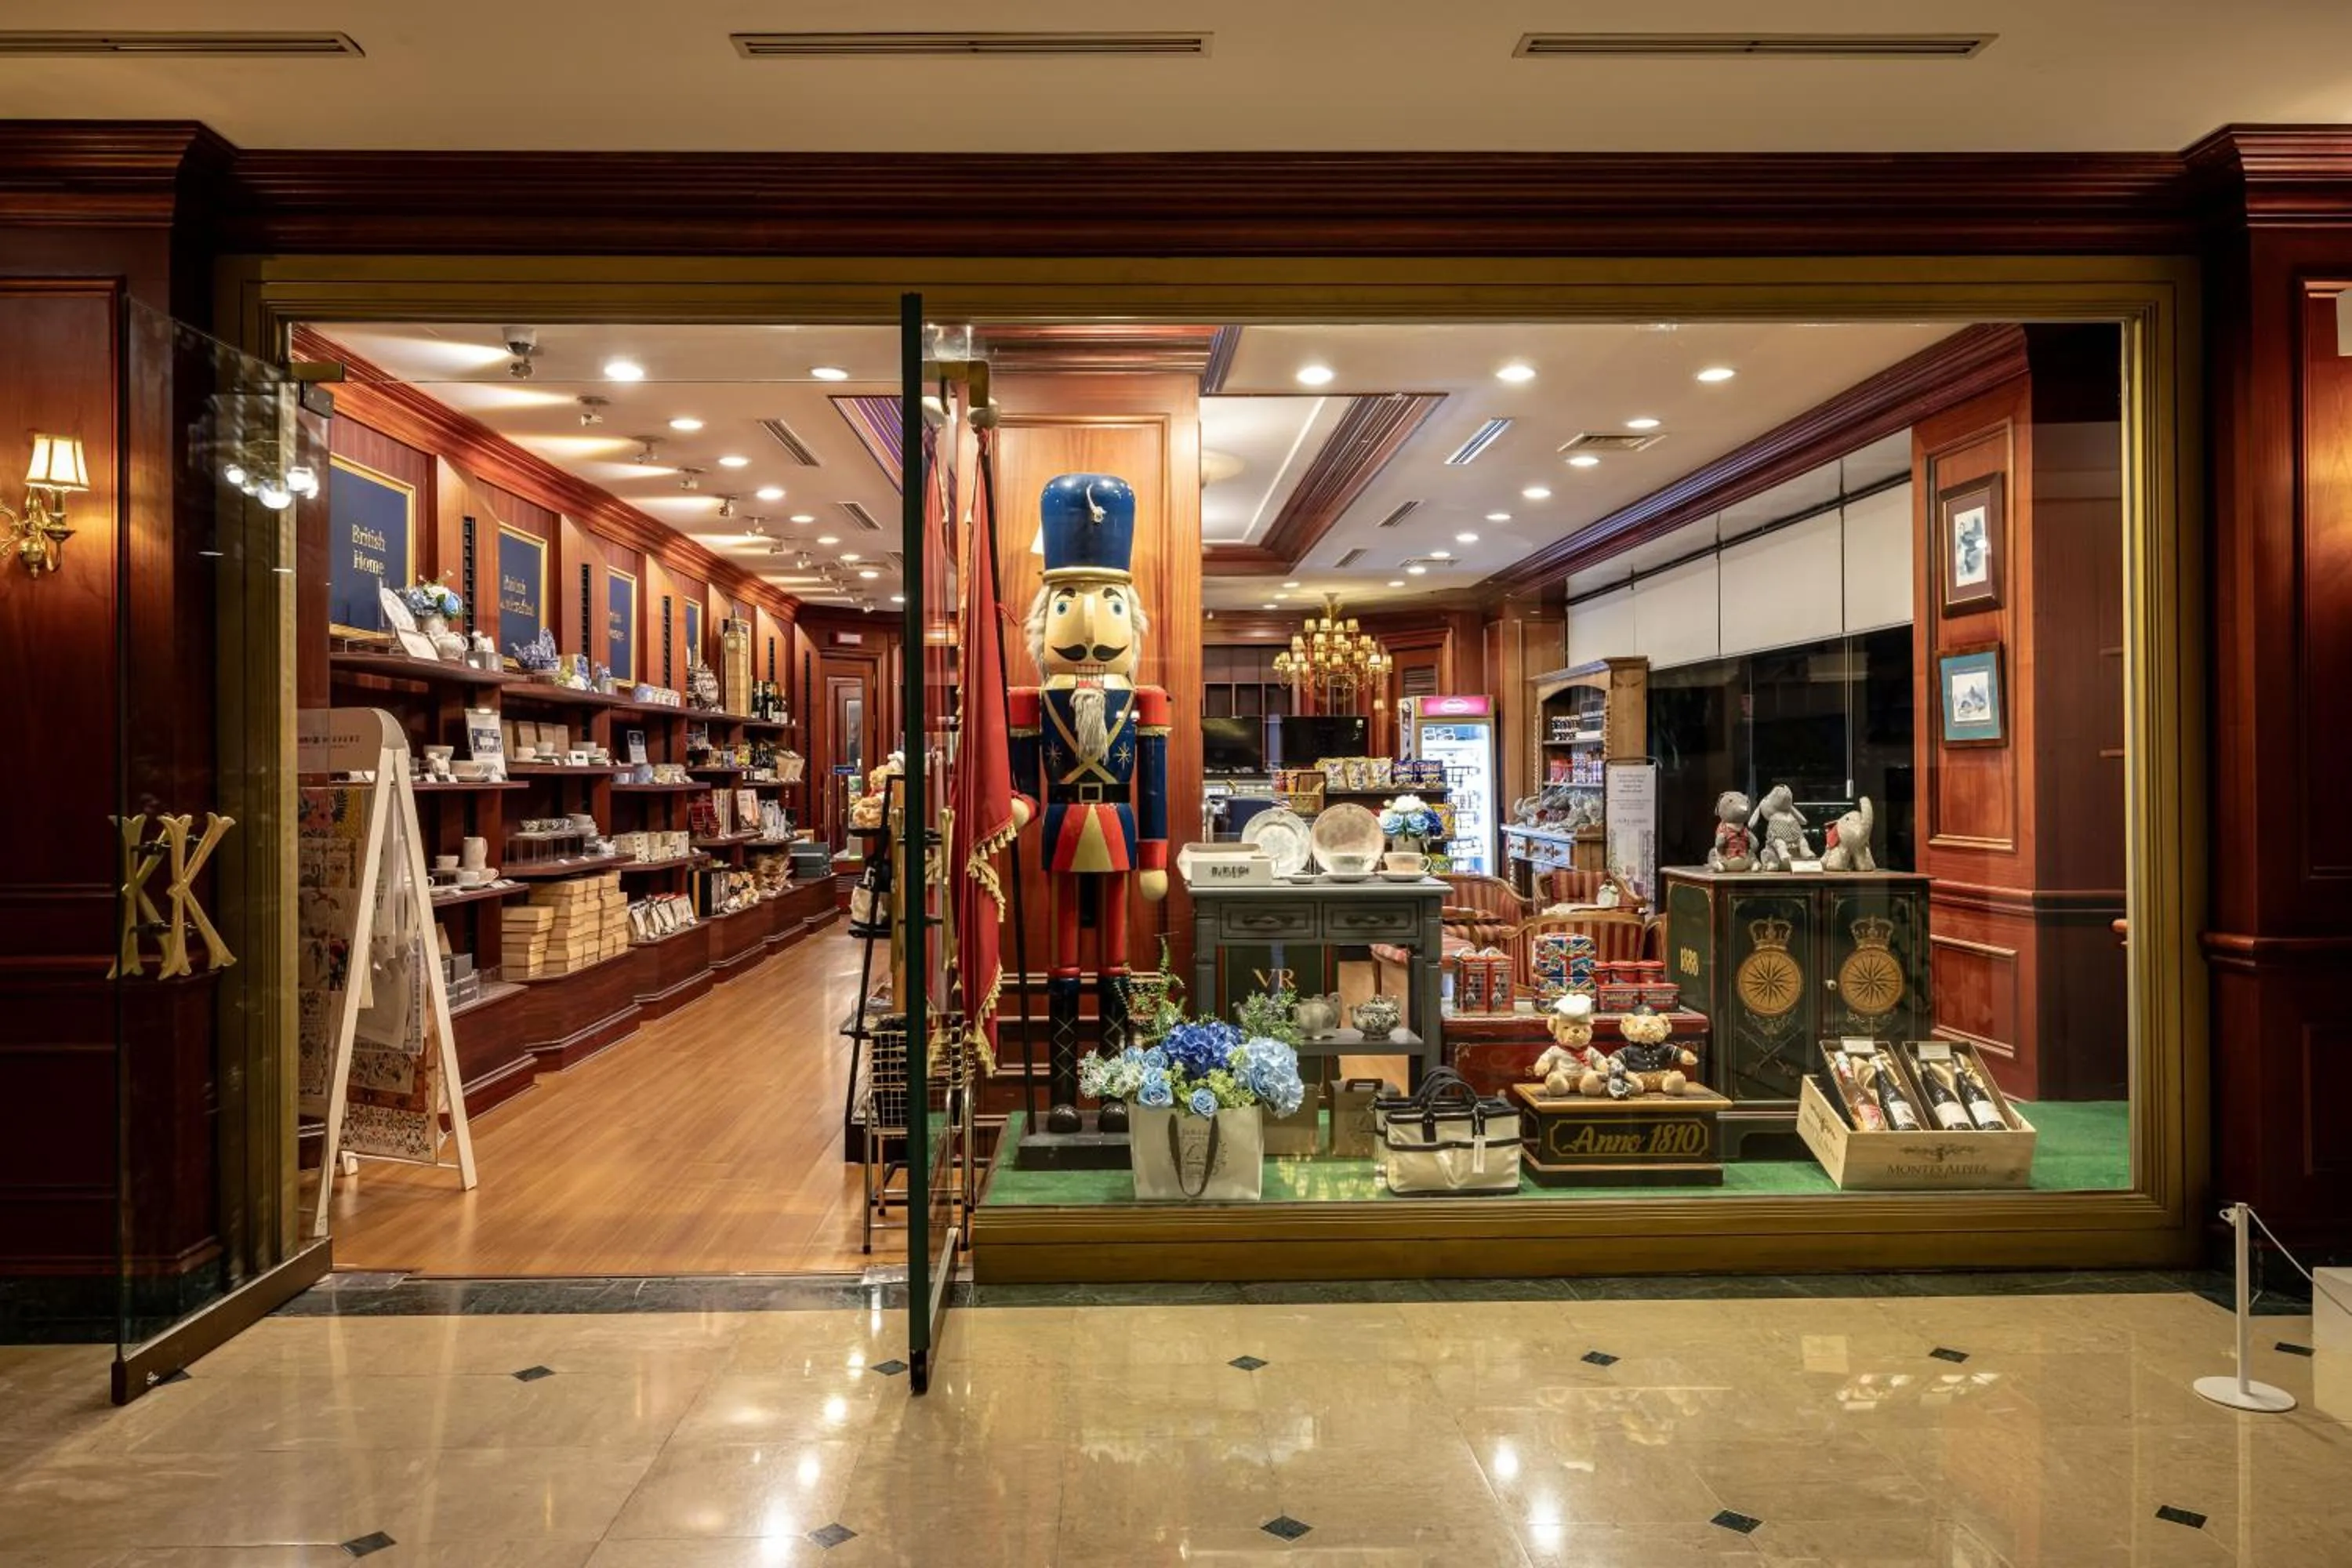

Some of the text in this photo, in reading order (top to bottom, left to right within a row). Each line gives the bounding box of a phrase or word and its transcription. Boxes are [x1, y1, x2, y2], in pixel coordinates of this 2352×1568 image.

[351, 523, 387, 552] British
[353, 549, 385, 575] Home
[1253, 967, 1296, 989] VR
[1561, 1123, 1700, 1153] Anno 1810
